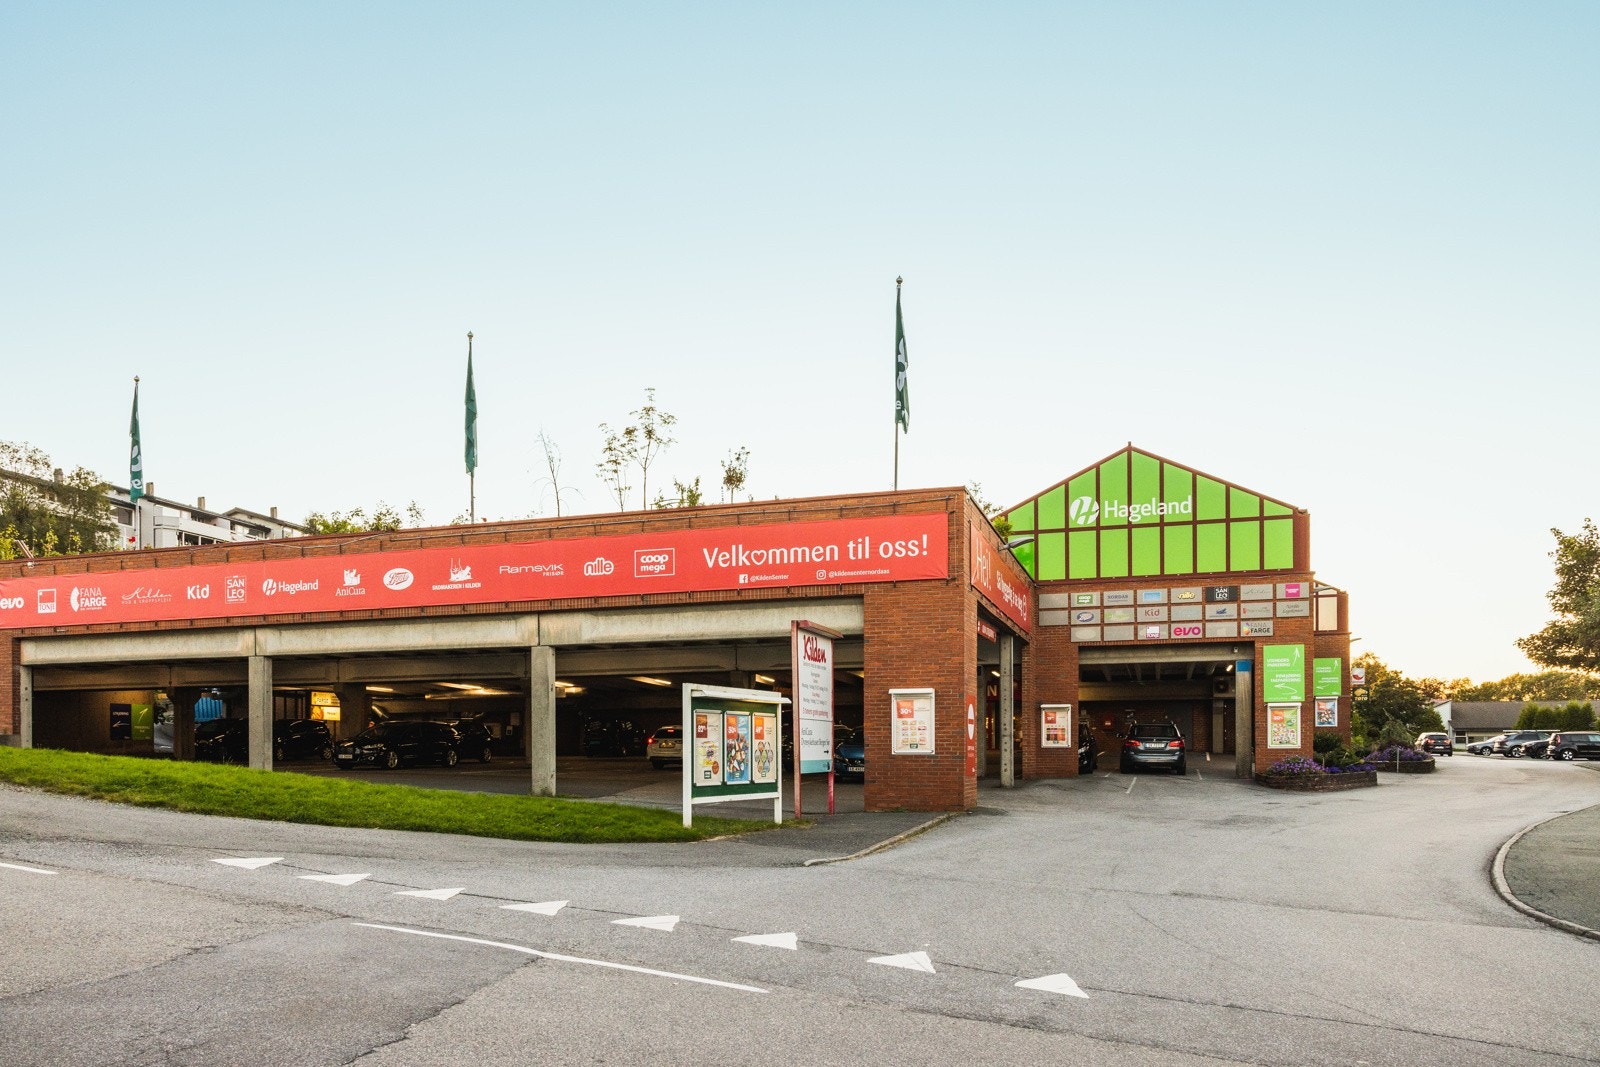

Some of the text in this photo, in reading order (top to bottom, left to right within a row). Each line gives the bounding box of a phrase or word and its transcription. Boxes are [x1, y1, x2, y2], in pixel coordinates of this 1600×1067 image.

[1104, 495, 1192, 522] Hageland
[847, 536, 870, 560] til
[879, 534, 928, 559] oss!
[640, 553, 669, 564] coop
[584, 557, 614, 576] nille
[640, 563, 666, 573] mega
[80, 587, 103, 597] FANA
[187, 585, 210, 600] Kid
[278, 579, 319, 595] Hageland
[335, 586, 366, 597] AniCura
[227, 588, 245, 599] LEO
[0, 597, 25, 609] evo
[80, 597, 108, 607] FARGE
[1144, 608, 1160, 617] Kid
[1173, 626, 1201, 637] evo
[803, 634, 827, 663] Kilden
